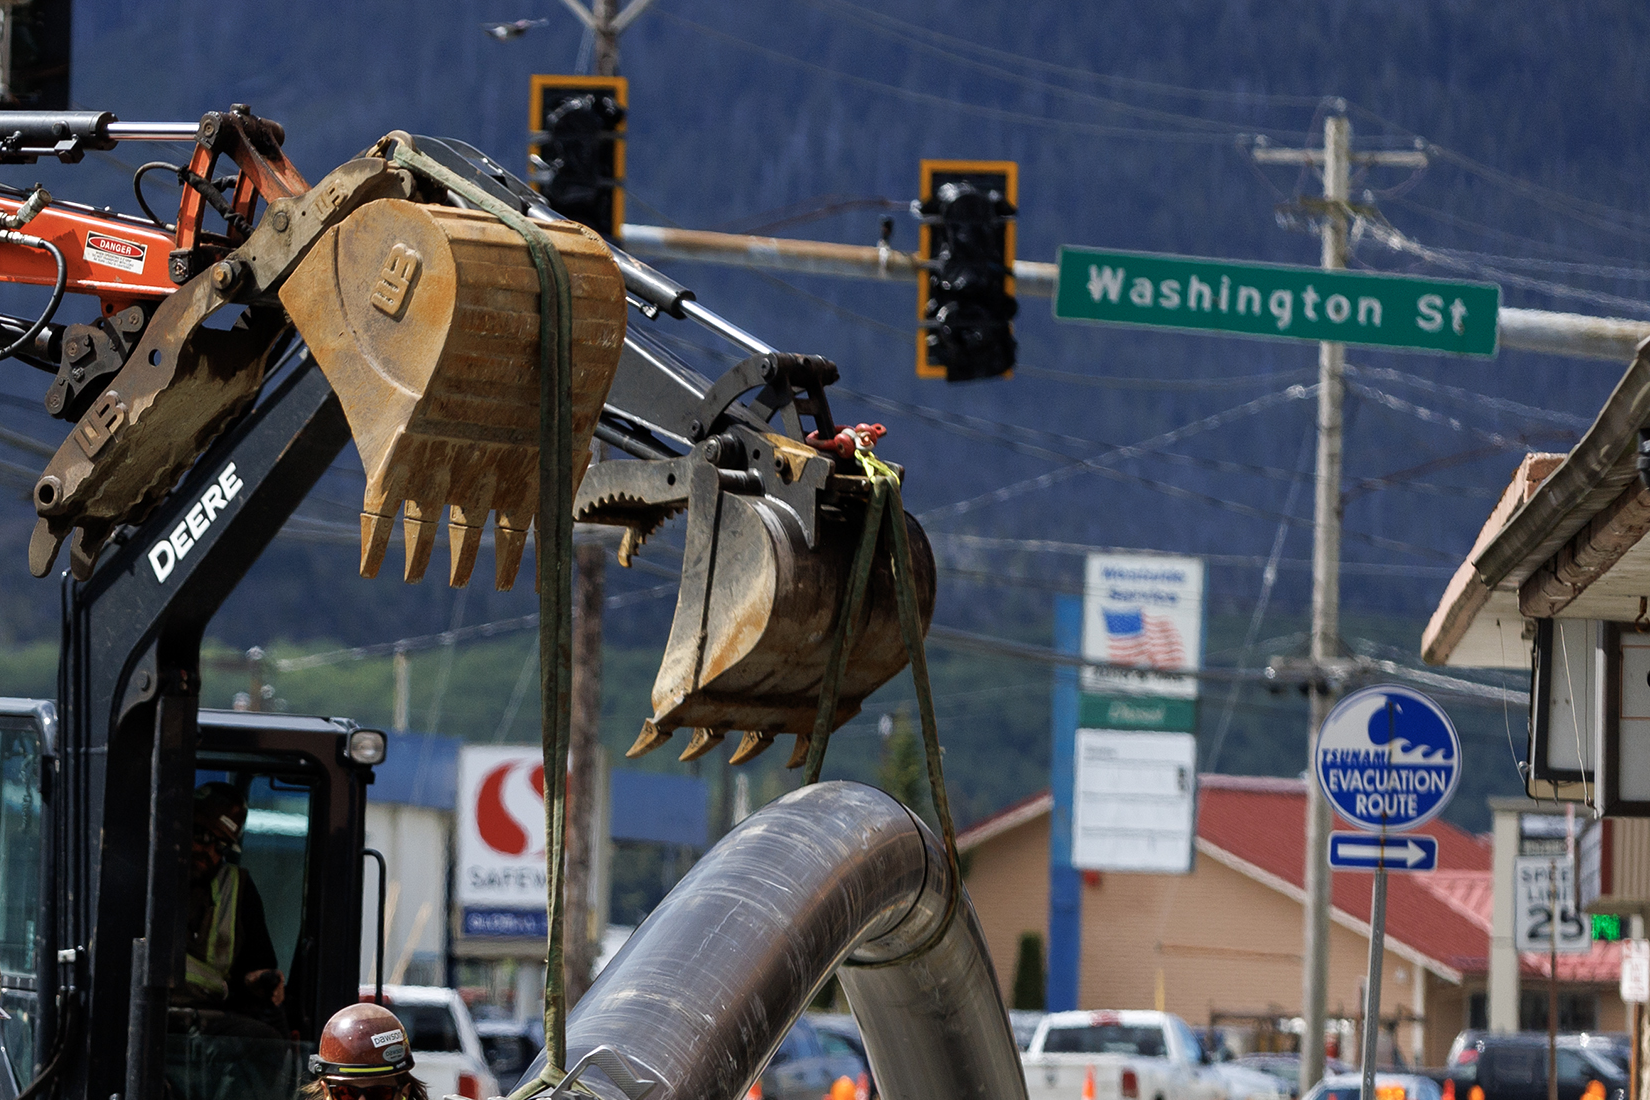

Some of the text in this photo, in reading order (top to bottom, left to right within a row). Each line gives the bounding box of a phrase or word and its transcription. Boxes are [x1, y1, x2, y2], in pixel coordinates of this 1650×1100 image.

[100, 239, 132, 255] DANGER
[1088, 264, 1469, 336] Washington St
[148, 461, 244, 584] DEERE
[1321, 748, 1392, 766] TSUNAMI
[1329, 768, 1447, 793] EVACUATION
[1355, 793, 1418, 817] ROUTE
[468, 865, 548, 890] SAFEW
[1528, 904, 1584, 939] 25
